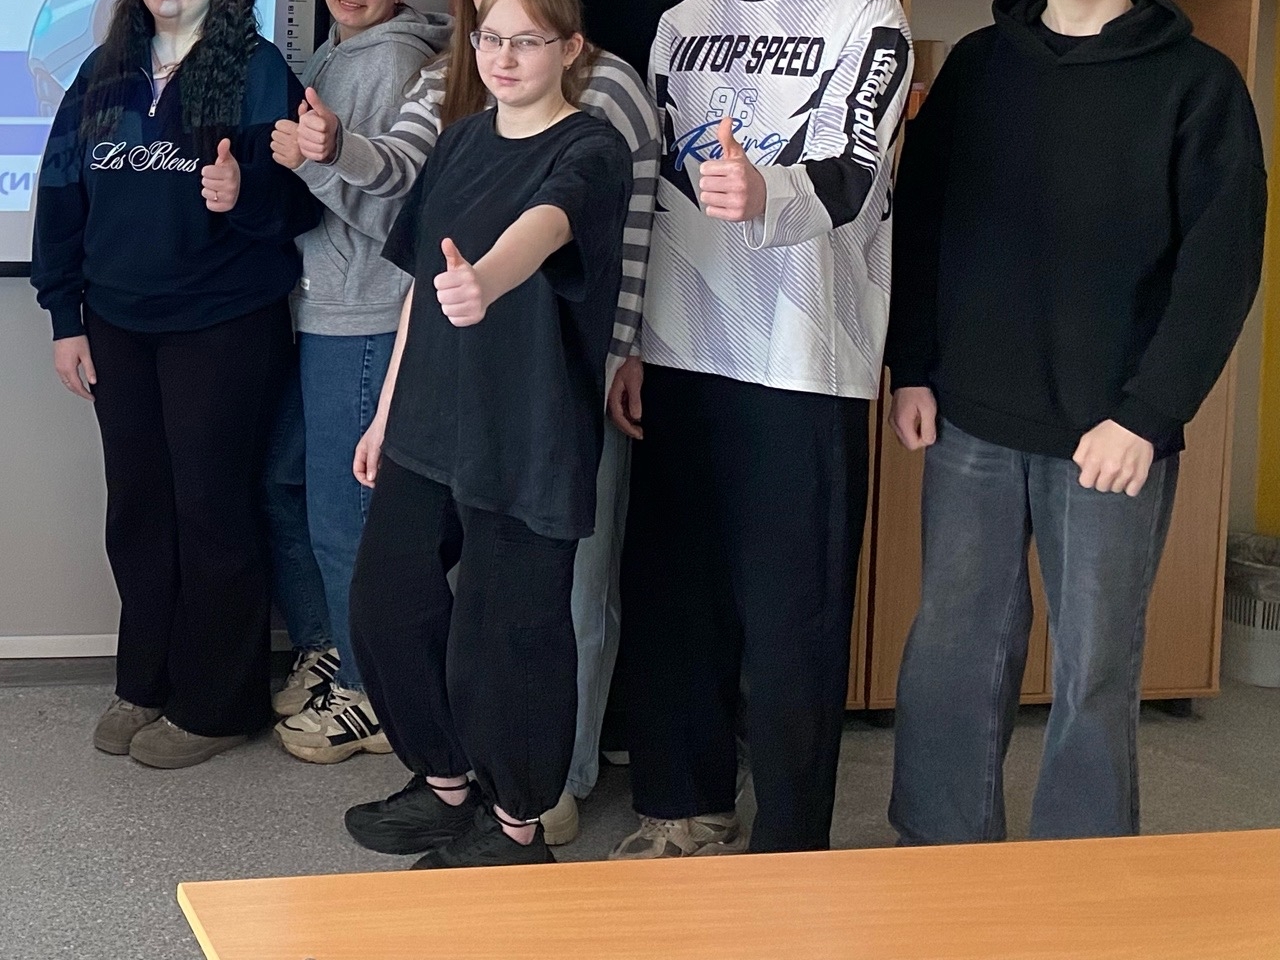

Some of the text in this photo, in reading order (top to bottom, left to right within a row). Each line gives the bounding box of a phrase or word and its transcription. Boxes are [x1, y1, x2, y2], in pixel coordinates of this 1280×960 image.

[696, 34, 826, 78] TOP SPEED
[705, 86, 759, 128] 96
[90, 141, 127, 170] Les
[128, 140, 200, 172] Bleus
[670, 117, 789, 172] Raing
